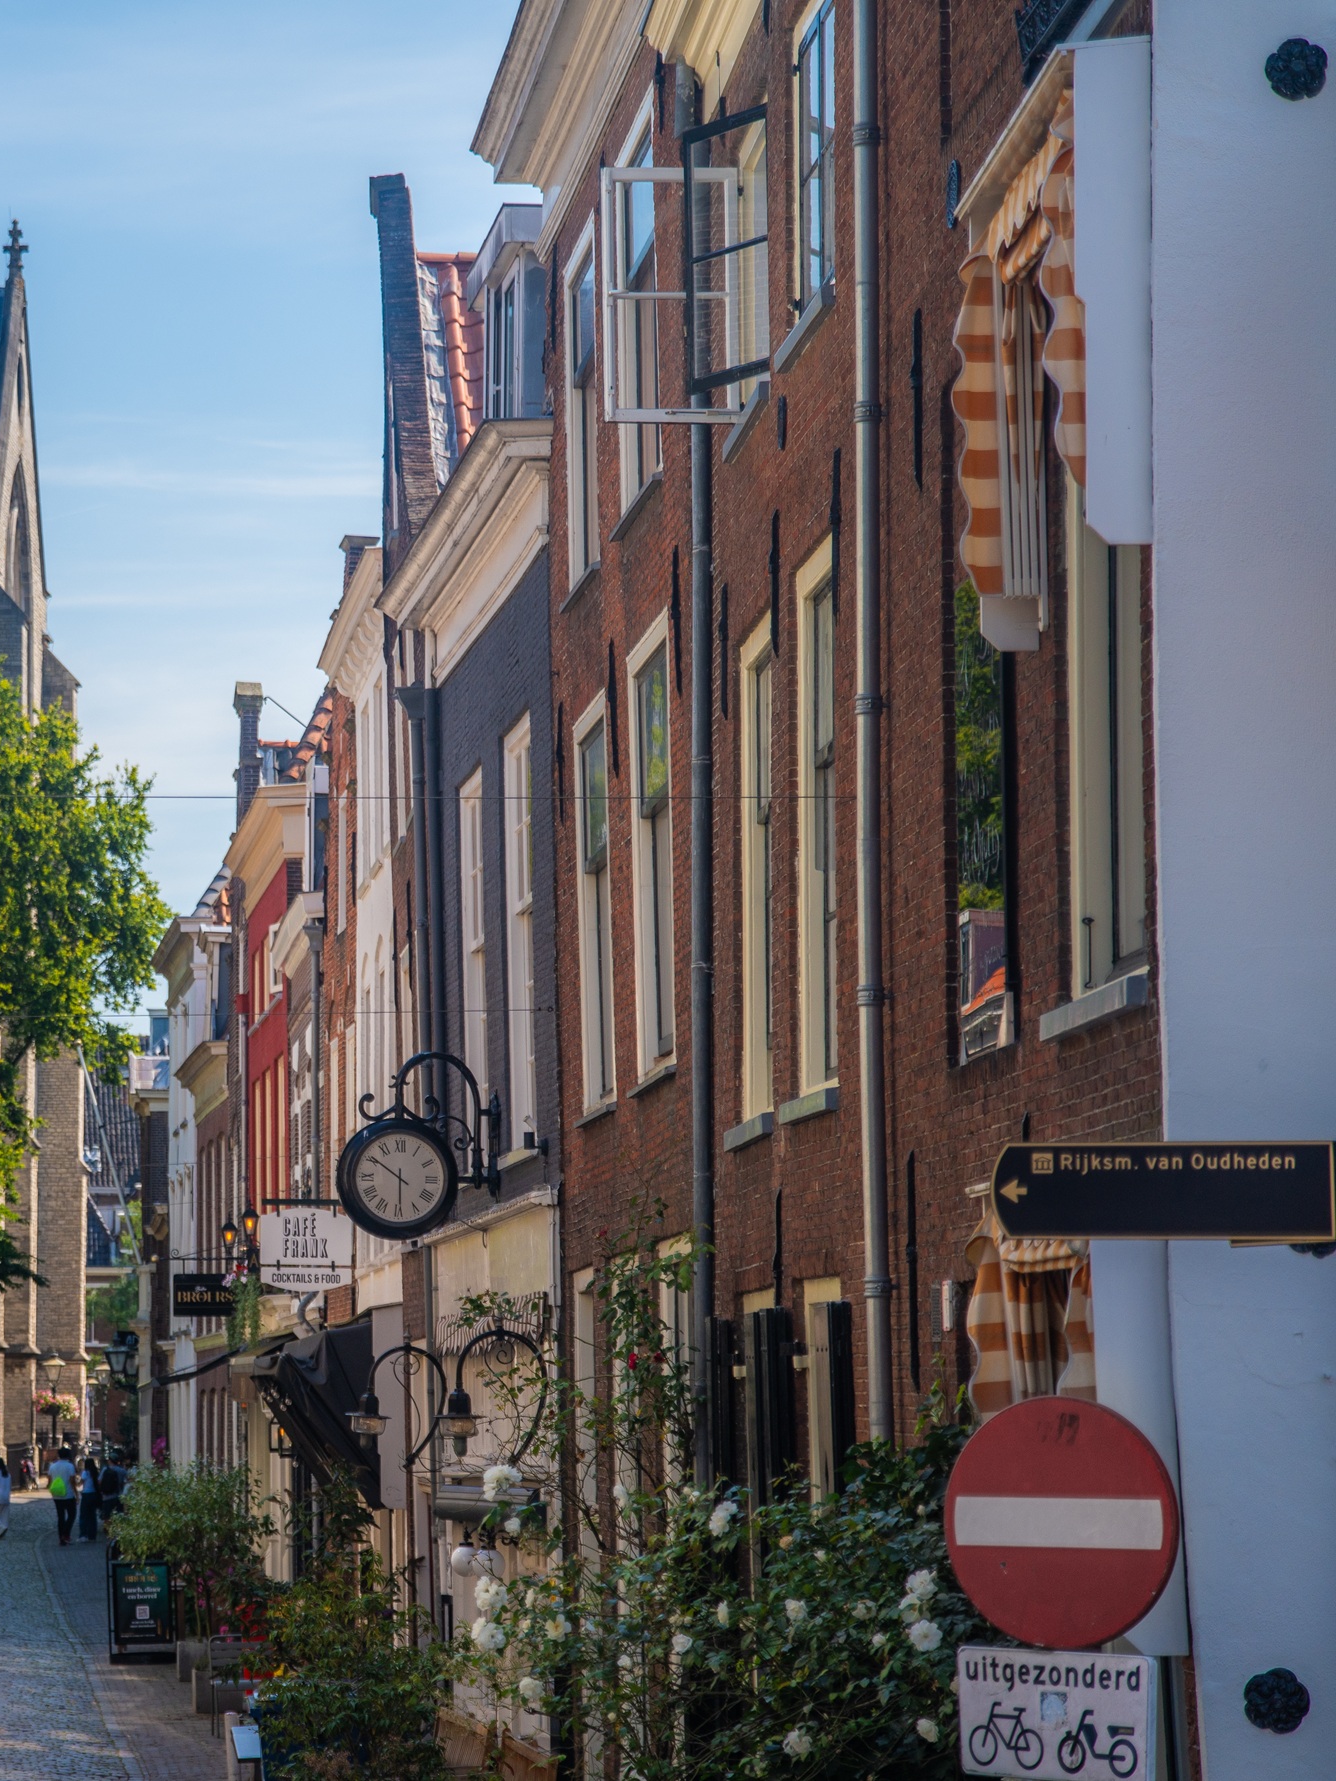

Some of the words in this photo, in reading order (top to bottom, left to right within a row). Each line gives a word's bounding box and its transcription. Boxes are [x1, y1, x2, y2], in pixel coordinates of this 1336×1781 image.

[395, 1140, 406, 1153] XII
[1060, 1153, 1139, 1175] Rijksm.
[1146, 1156, 1183, 1170] van
[1191, 1153, 1296, 1170] Oudheden
[282, 1212, 317, 1237] CAFÉ
[282, 1238, 328, 1258] FRANK
[272, 1273, 312, 1284] COCKTAILS
[314, 1274, 320, 1284] &
[321, 1274, 341, 1284] FOOD
[965, 1656, 1141, 1692] uitgezonderd
